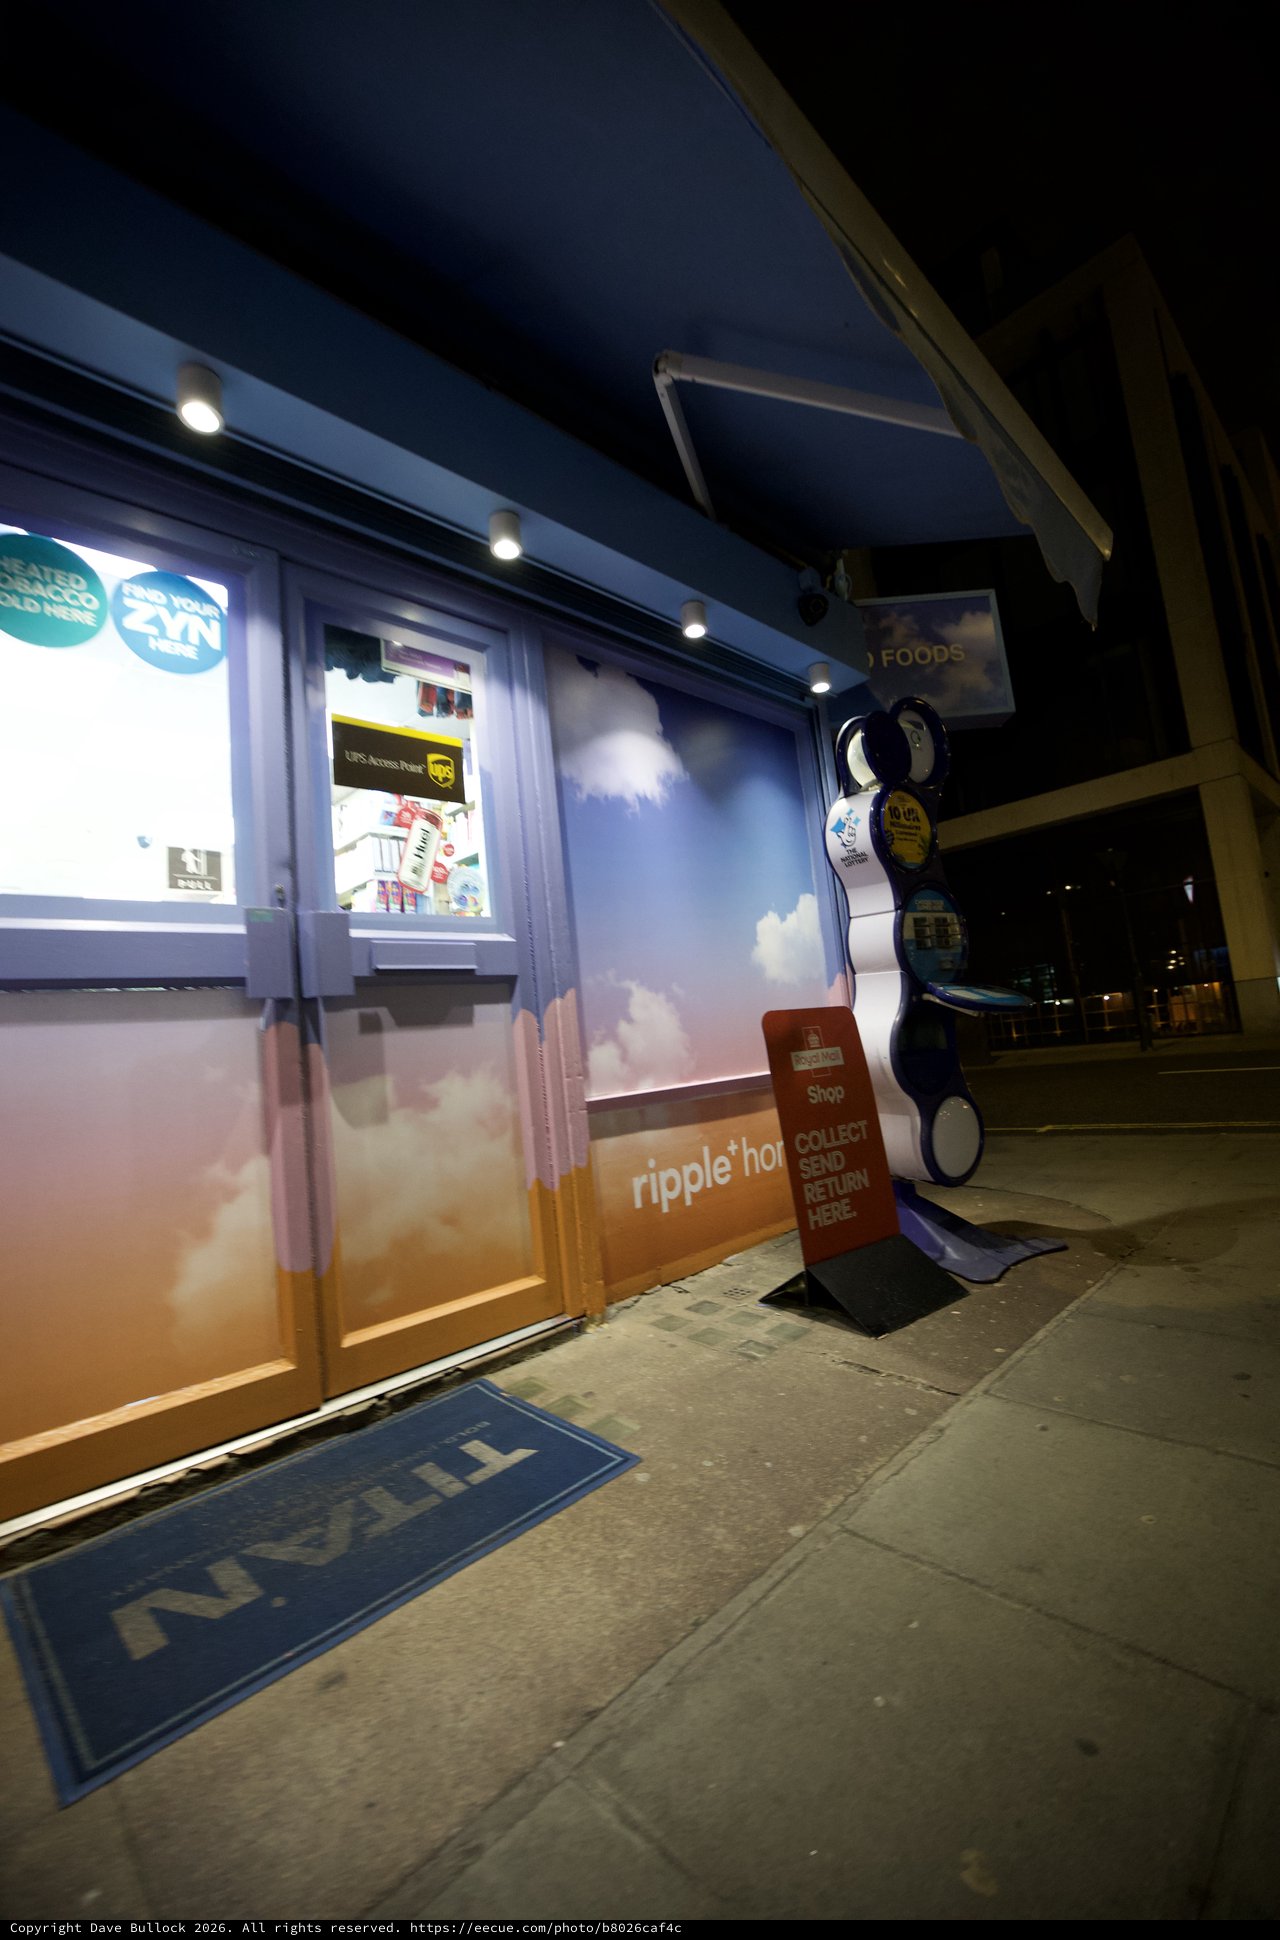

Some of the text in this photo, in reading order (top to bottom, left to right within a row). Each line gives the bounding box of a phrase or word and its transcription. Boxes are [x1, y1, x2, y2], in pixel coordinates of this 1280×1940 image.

[0, 572, 100, 611] OBACCO
[122, 582, 220, 619] FIND YOUR
[0, 591, 97, 627] OLD HERE
[122, 597, 222, 651] ZYN
[148, 636, 199, 660] HERE
[880, 644, 966, 668] FOODS
[345, 750, 368, 764] UPS
[368, 754, 400, 770] Access
[888, 806, 901, 821] 10
[841, 852, 869, 863] NATIONAL
[844, 857, 870, 868] LOTTERY
[794, 1048, 842, 1068] Royal Mail
[807, 1083, 845, 1105] Shop
[794, 1120, 869, 1154] COLLECT
[799, 1150, 846, 1180] SEND
[803, 1167, 871, 1205] RETURN
[807, 1198, 859, 1231] HERE.
[110, 1438, 540, 1662] TITAN
